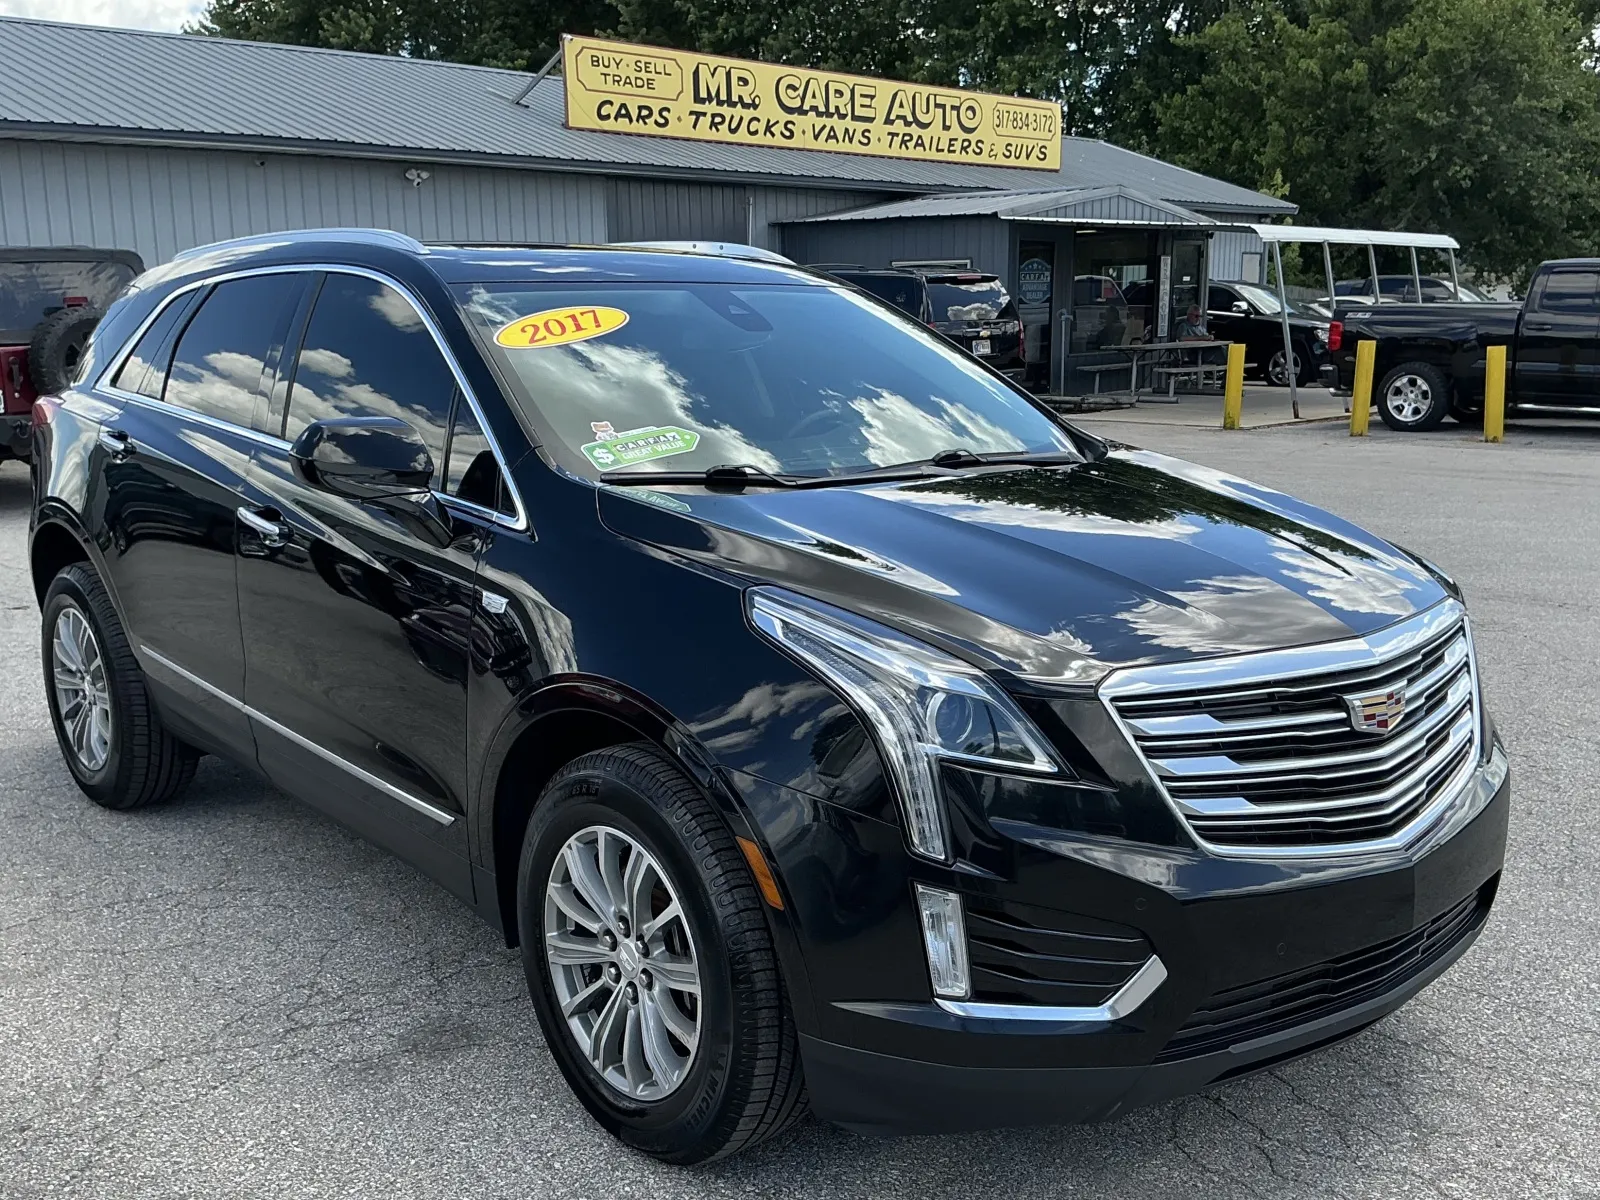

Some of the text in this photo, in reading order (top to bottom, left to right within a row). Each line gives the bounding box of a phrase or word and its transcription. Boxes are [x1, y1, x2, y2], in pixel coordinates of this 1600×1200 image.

[590, 54, 672, 77] BUY SELL
[600, 72, 656, 91] TRADE
[692, 62, 983, 134] MR. CARE AUTO
[596, 99, 1048, 162] CARS TRUCKS VANS TRAILERS & SUV'S
[1020, 272, 1051, 281] CARFAX
[520, 309, 602, 345] 2017
[613, 432, 681, 453] CARFAX
[621, 440, 686, 460] GREAT VALUE
